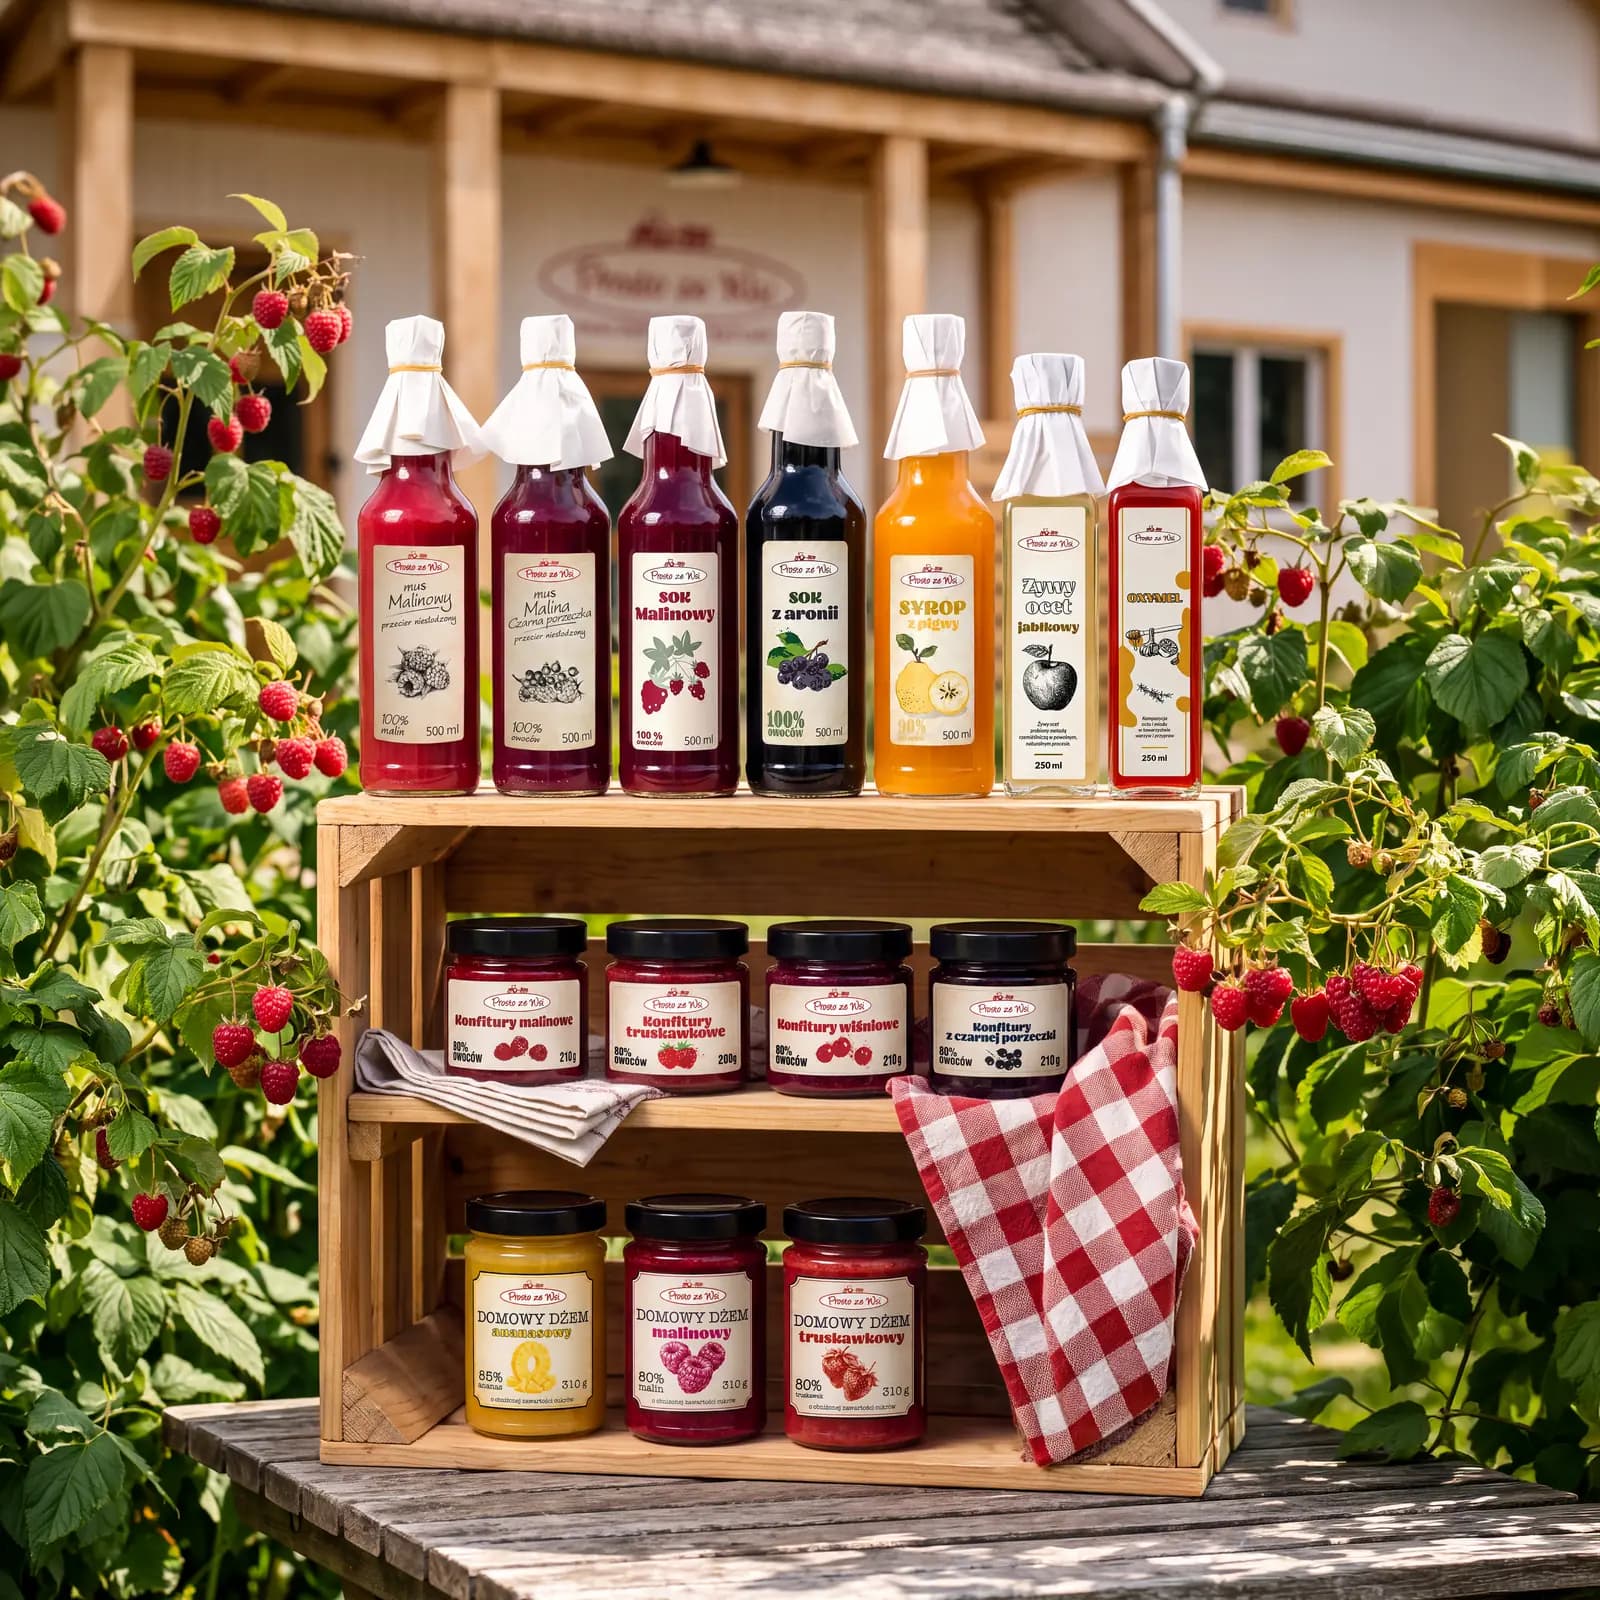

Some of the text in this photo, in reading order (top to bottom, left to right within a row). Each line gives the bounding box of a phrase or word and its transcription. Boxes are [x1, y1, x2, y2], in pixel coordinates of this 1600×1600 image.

[1027, 539, 1047, 548] Prosto
[1135, 534, 1152, 542] Prosto
[394, 561, 416, 571] Prosto
[428, 561, 442, 571] Wsi
[780, 565, 802, 574] Prosto
[817, 564, 832, 574] Wsi
[526, 569, 547, 578] Prosto
[560, 570, 574, 578] Wsi
[651, 571, 673, 580] Prosto
[687, 571, 700, 580] Wsi
[909, 575, 931, 585] Prosto
[944, 575, 958, 584] Wsi
[404, 582, 426, 592] mus
[534, 590, 556, 598] mus
[659, 592, 691, 603] SOK
[789, 592, 822, 604] SOK
[1127, 593, 1183, 603] OXYMEL
[388, 591, 453, 612] Malinowy
[1025, 599, 1072, 615] ocet
[524, 600, 570, 617] Malina
[772, 605, 839, 620] z aronii
[899, 600, 966, 616] SYROP
[508, 608, 592, 629] Czarna porzeczka
[636, 607, 715, 623] Malinowy
[381, 615, 457, 632] przecier niesłodzony
[908, 618, 960, 631] z pigwy
[514, 633, 543, 645] przecier
[382, 714, 409, 726] 100%
[767, 710, 805, 728] 100%
[381, 728, 404, 736] malin
[426, 724, 459, 736] 500 ml
[512, 722, 542, 734] 100%
[768, 728, 803, 737] owoców
[816, 726, 843, 737] 500 ml
[511, 735, 540, 743] owoców
[562, 731, 592, 743] 500 ml
[637, 731, 652, 740] 100
[943, 728, 971, 740] 500 ml
[684, 734, 713, 746] 500 ml
[1052, 761, 1062, 769] ml
[491, 997, 516, 1008] Prosto
[530, 997, 544, 1007] Wsi
[652, 999, 703, 1010] Prosto ze Wsi
[813, 1001, 836, 1011] Prosto
[850, 1000, 865, 1010] Wsi
[978, 1003, 1001, 1014] Prosto
[1015, 1003, 1029, 1013] Wsi
[455, 1015, 573, 1030] Konfitury malinowe
[643, 1016, 712, 1028] Konfitury
[777, 1018, 899, 1034] Konfitury wiśniowe
[626, 1026, 725, 1040] truskawkowe
[973, 1023, 1031, 1033] Konfitury
[945, 1029, 1057, 1045] z czarnej porzeczki
[453, 1042, 469, 1052] 80%
[614, 1047, 632, 1057] 80%
[775, 1045, 792, 1056] 80%
[939, 1047, 957, 1057] 80%
[560, 1051, 576, 1063] 210g
[718, 1055, 737, 1065] 200g
[883, 1054, 901, 1067] 210g
[1041, 1056, 1060, 1067] 210g
[508, 1292, 532, 1302] Prosto
[544, 1292, 560, 1301] Wsi
[668, 1291, 692, 1301] Prosto
[704, 1291, 719, 1300] Wsi
[828, 1296, 852, 1306] Prosto
[866, 1296, 881, 1305] Wsi
[478, 1310, 589, 1324] DOMOWY DŻEM
[636, 1308, 748, 1323] DOMOWY DŻEM
[794, 1314, 910, 1329] DOMOWY DŻEM
[492, 1328, 572, 1339] ananasowy
[652, 1326, 732, 1340] malinowy
[799, 1331, 905, 1345] truskawkowy
[479, 1370, 503, 1382] 85%
[638, 1371, 664, 1384] 80%
[479, 1382, 502, 1390] ananas
[562, 1380, 588, 1389] 310 g
[638, 1384, 664, 1393] malin
[722, 1380, 748, 1390] 310 g
[796, 1379, 822, 1391] 80%
[883, 1386, 910, 1397] 310 g
